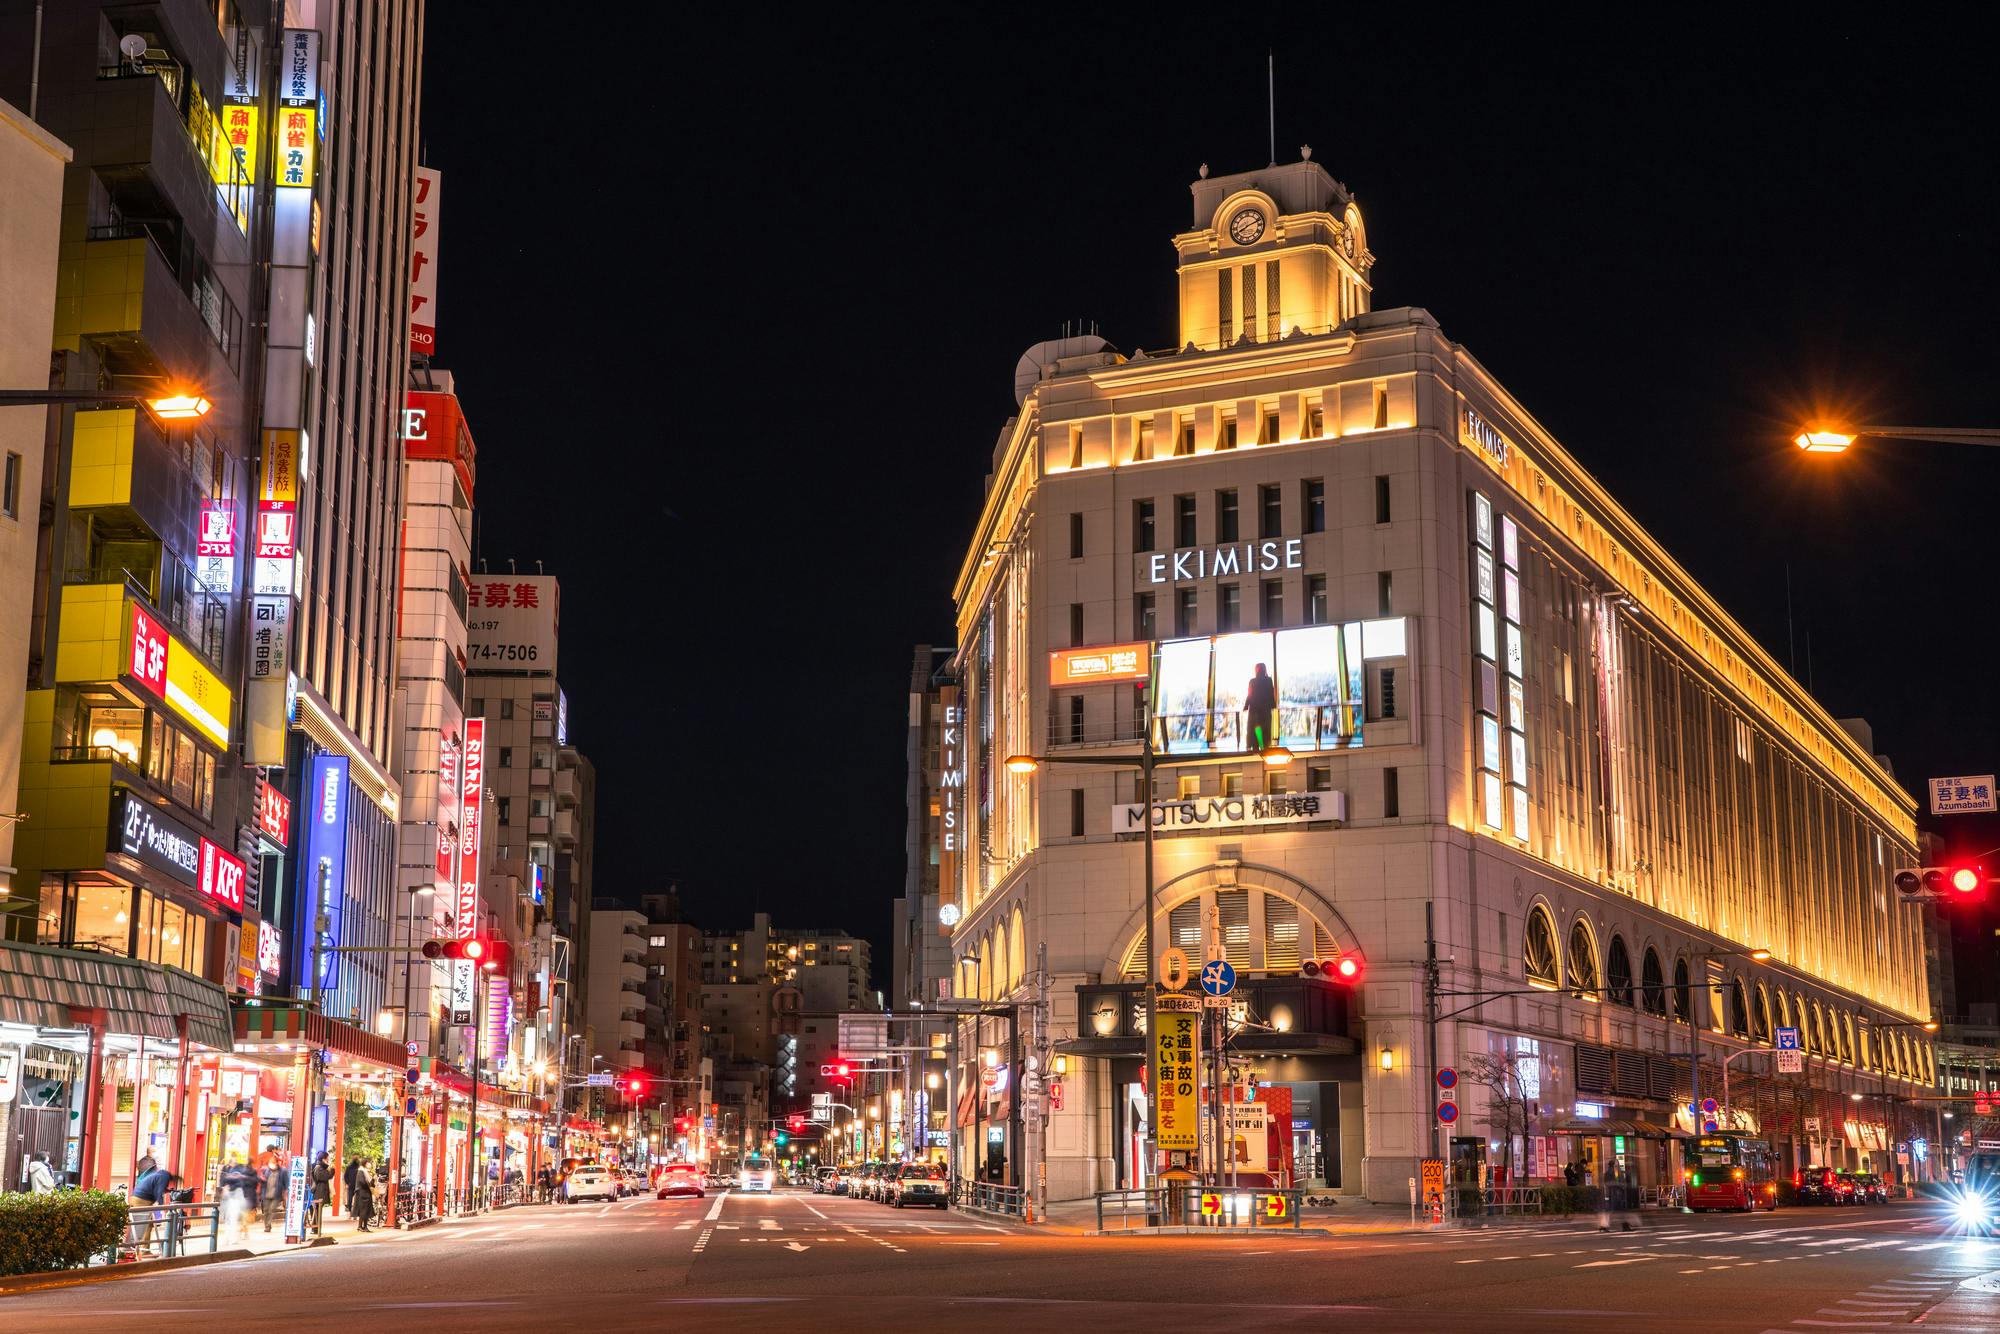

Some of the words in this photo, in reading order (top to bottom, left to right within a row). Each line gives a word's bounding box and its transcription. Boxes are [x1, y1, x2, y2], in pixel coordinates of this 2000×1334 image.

[292, 33, 308, 97] 茶道いけばな教室
[285, 112, 307, 183] 麻雀カボ
[1467, 410, 1509, 469] EKIMISE
[271, 501, 284, 510] 3F
[259, 545, 292, 556] KFC
[1151, 539, 1303, 583] EKIMISE
[148, 638, 165, 682] 3F
[467, 645, 537, 661] 74-7506
[465, 739, 481, 795] カラオケ
[942, 707, 959, 850] EKIMISE
[324, 767, 340, 824] MIZUHO
[1252, 796, 1320, 819] 松屋浅草
[1938, 785, 1989, 802] 吾妻橋
[1938, 800, 1991, 811] Azumabashi
[125, 799, 142, 839] 2F
[465, 806, 475, 826] BIG
[462, 827, 475, 856] ECHO
[215, 856, 243, 904] KFC
[458, 881, 476, 939] カラオケ
[457, 1013, 468, 1022] 2F
[1177, 1018, 1193, 1097] 交通事故の
[1160, 1034, 1176, 1130] ない街浅草を
[1424, 1165, 1441, 1177] 200
